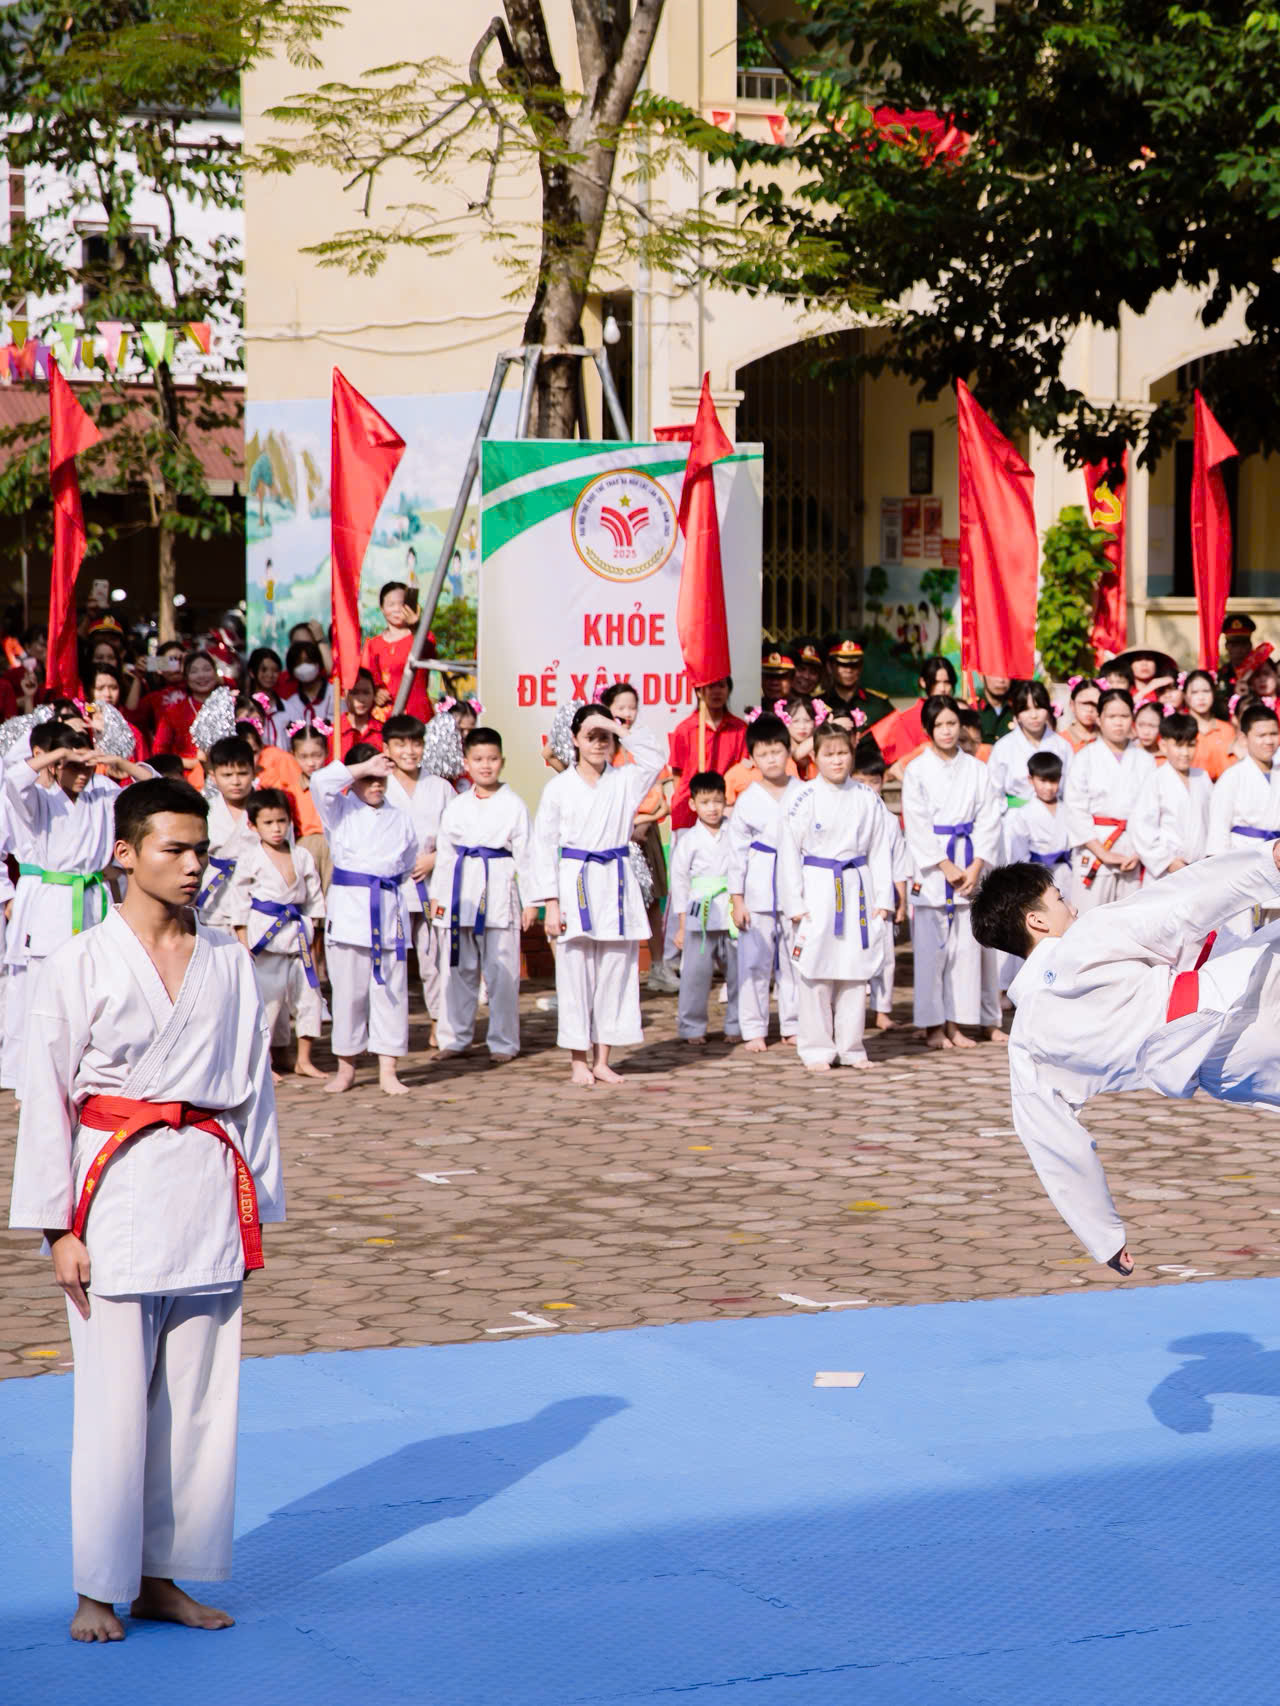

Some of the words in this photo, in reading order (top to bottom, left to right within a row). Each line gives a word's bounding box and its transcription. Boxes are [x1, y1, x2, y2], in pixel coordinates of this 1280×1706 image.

[613, 549, 637, 559] 2025
[583, 601, 665, 646] KHỎE
[517, 659, 560, 707] ĐỂ
